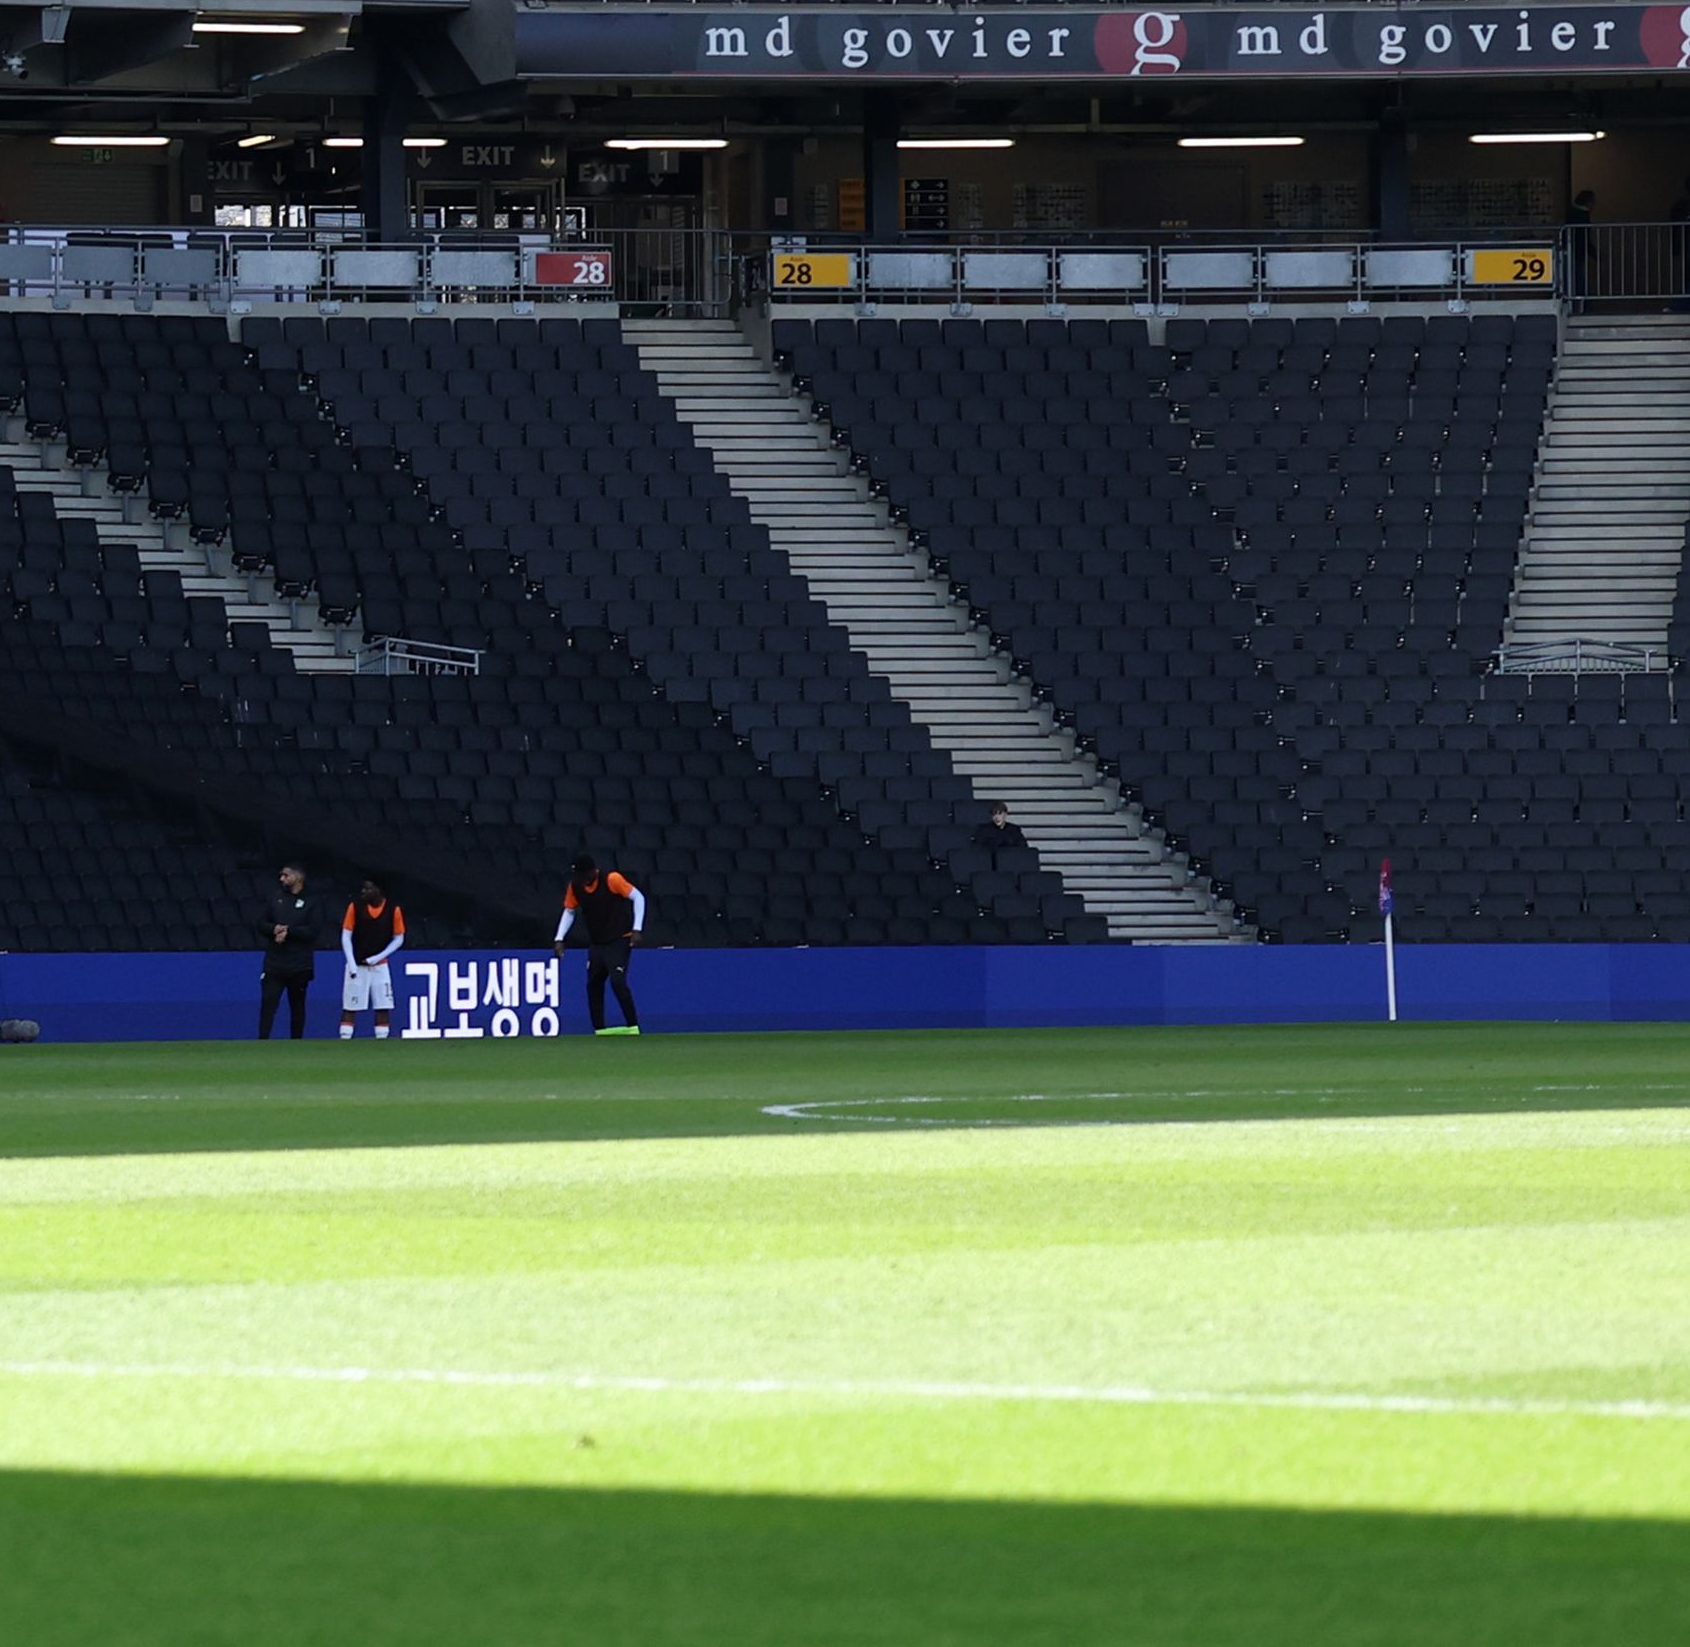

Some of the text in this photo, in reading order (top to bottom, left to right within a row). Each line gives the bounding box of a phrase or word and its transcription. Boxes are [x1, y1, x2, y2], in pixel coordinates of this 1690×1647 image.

[705, 15, 1071, 68] md govier
[1237, 10, 1616, 65] md govier
[462, 145, 515, 166] EXIT
[207, 161, 253, 181] EXIT
[578, 164, 631, 182] EXIT
[572, 261, 605, 284] 28
[781, 262, 812, 285] 28
[1512, 259, 1545, 281] 29
[401, 957, 559, 1039] 교보생명
